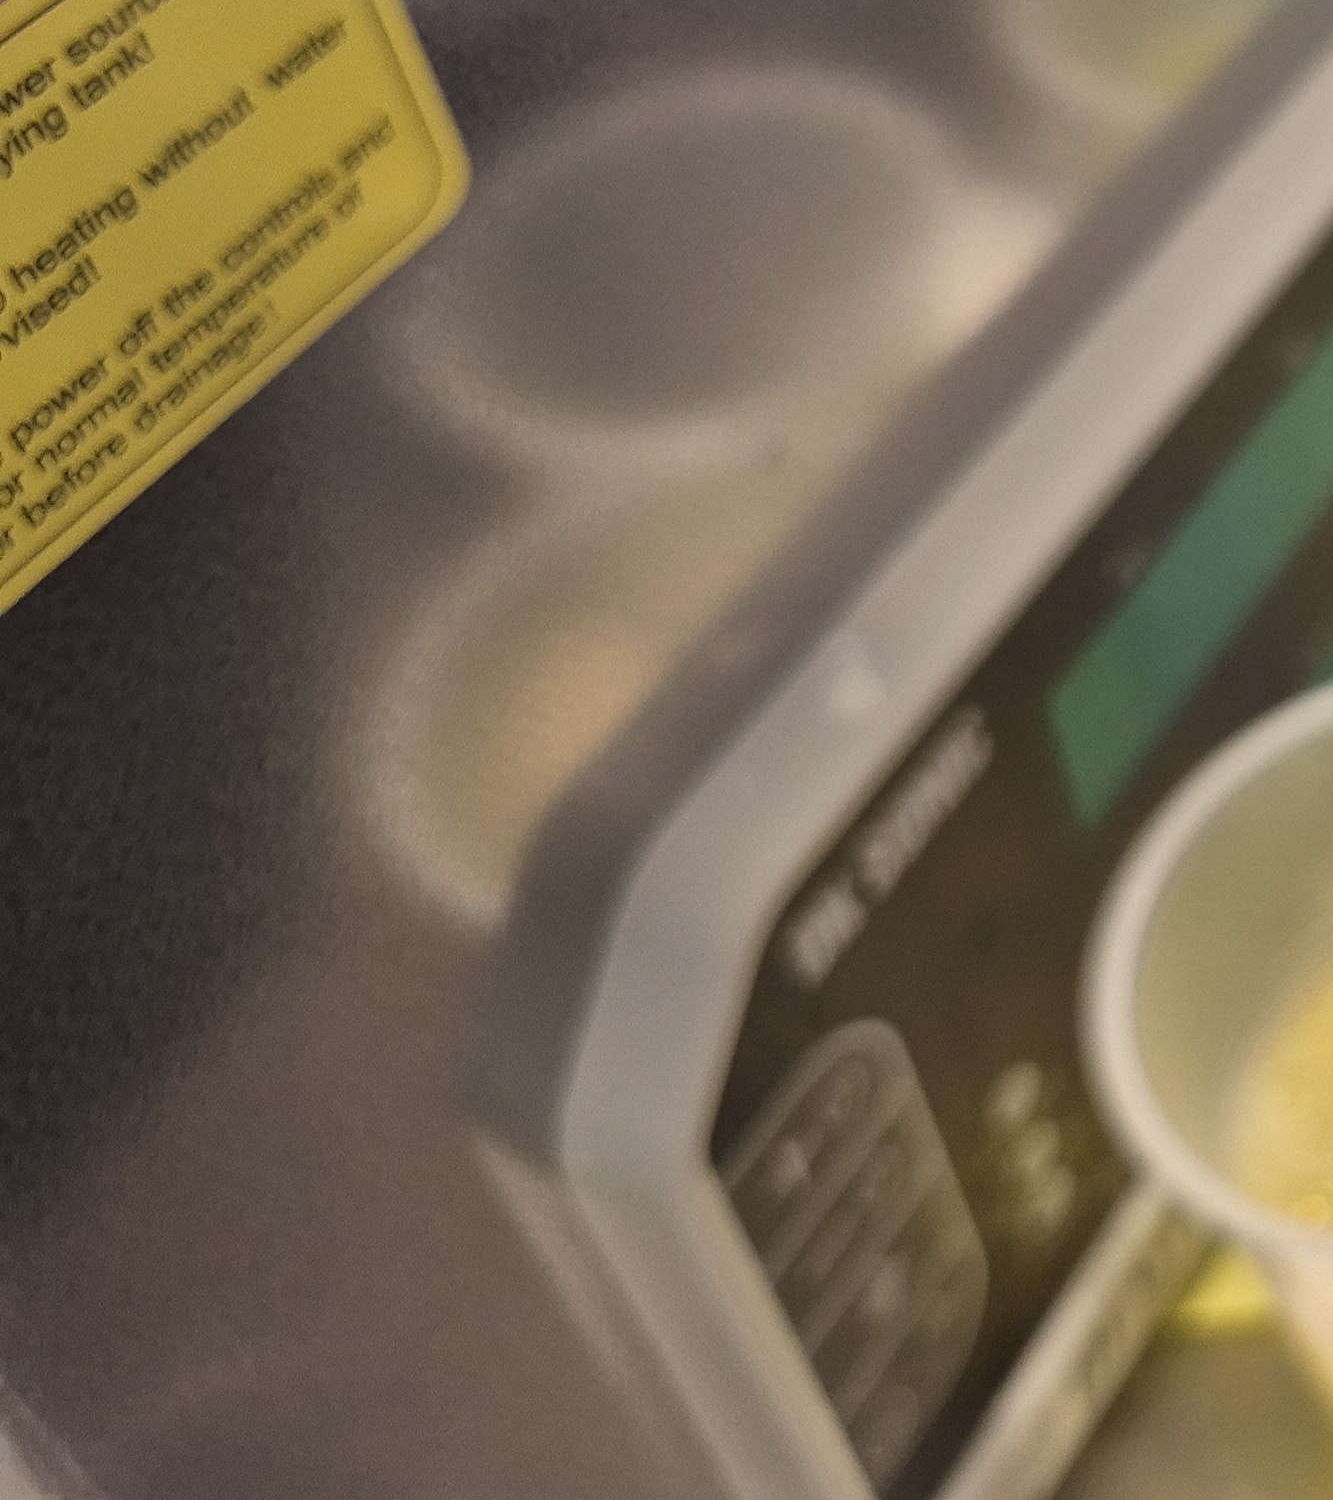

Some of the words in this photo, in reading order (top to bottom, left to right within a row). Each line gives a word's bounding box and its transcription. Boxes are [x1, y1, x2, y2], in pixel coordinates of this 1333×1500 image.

[8, 186, 140, 295] heating
[140, 86, 254, 190] without
[262, 16, 346, 91] water
[67, 30, 155, 112] tank!
[9, 354, 108, 453] power
[118, 308, 158, 360] off
[162, 267, 216, 319] the
[219, 168, 337, 272] controls
[34, 366, 145, 473] normal
[147, 217, 330, 374] temperature
[20, 432, 128, 531] before
